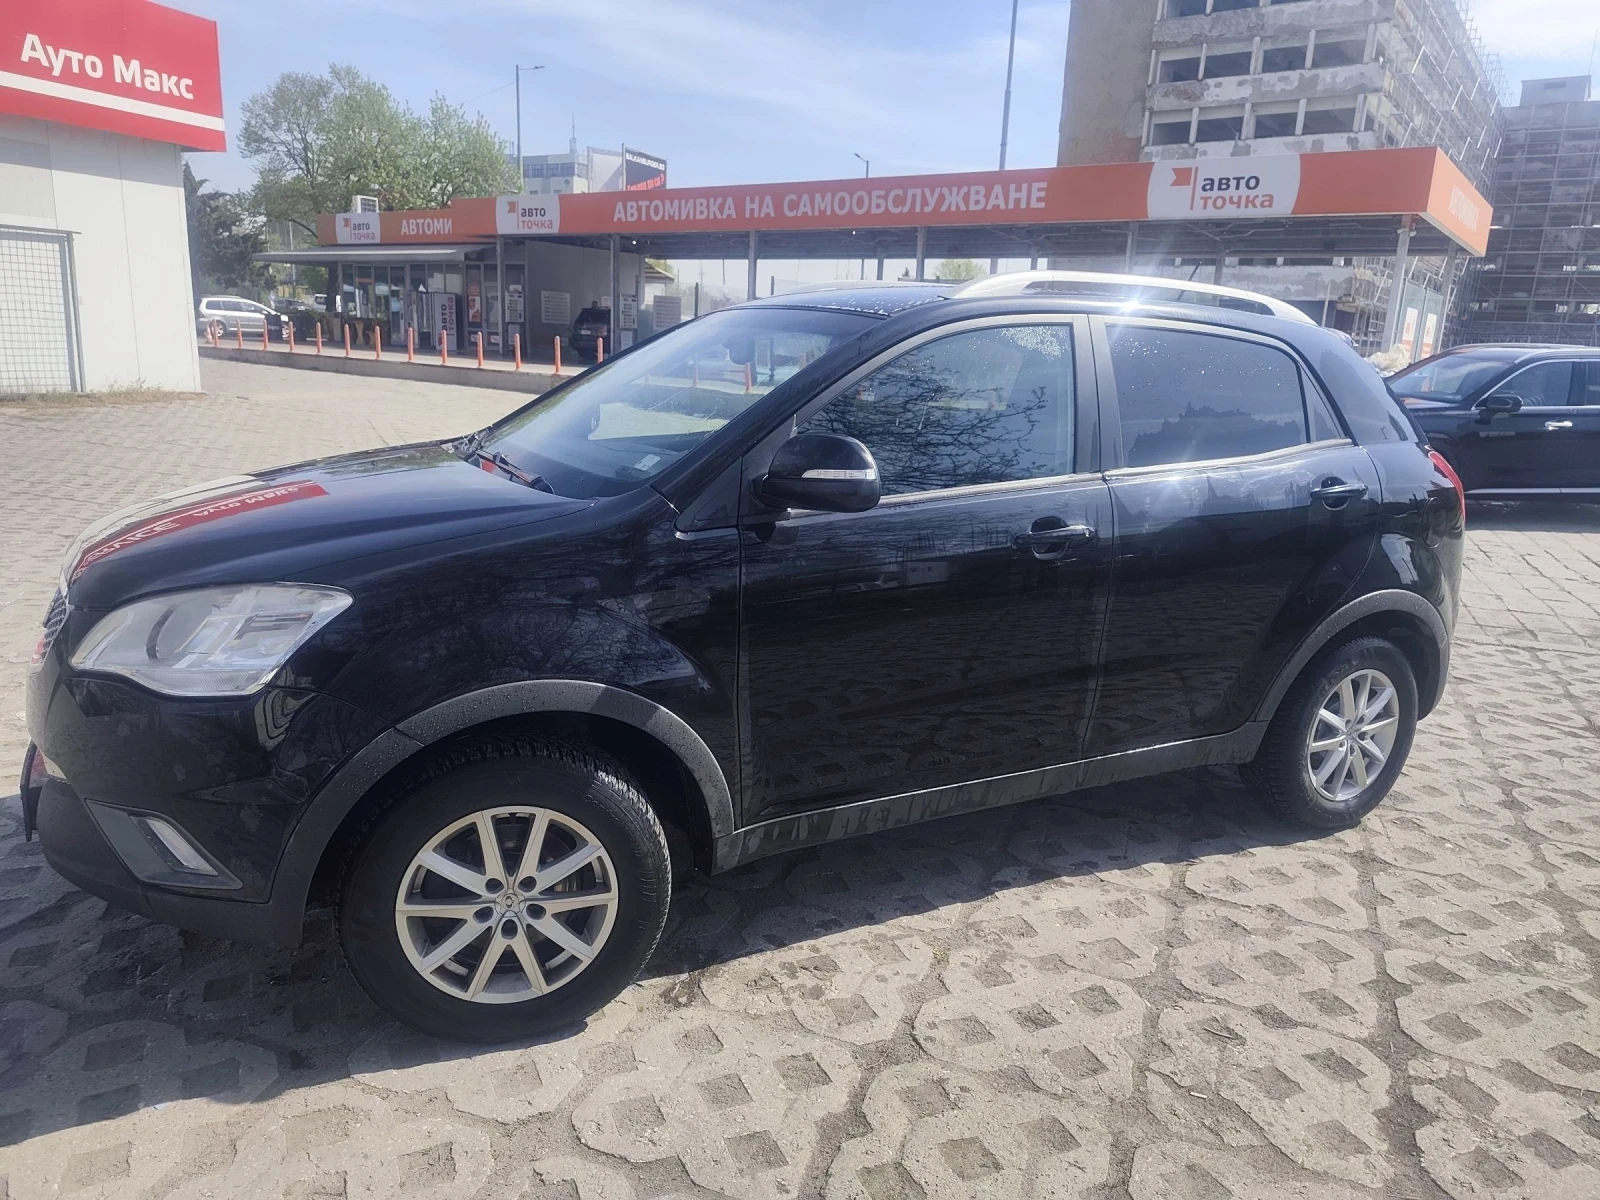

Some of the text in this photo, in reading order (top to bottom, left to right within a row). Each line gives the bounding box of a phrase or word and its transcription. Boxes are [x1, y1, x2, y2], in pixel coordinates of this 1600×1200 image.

[21, 33, 194, 100] Ауто Макс
[1201, 173, 1260, 192] авто
[613, 181, 1048, 223] АВТОМИВКА НА САМООБСЛУЖВАНЕ
[1200, 191, 1274, 211] точка
[521, 206, 546, 218] авто
[352, 222, 370, 231] авто
[521, 218, 553, 230] точка
[353, 232, 376, 240] точка
